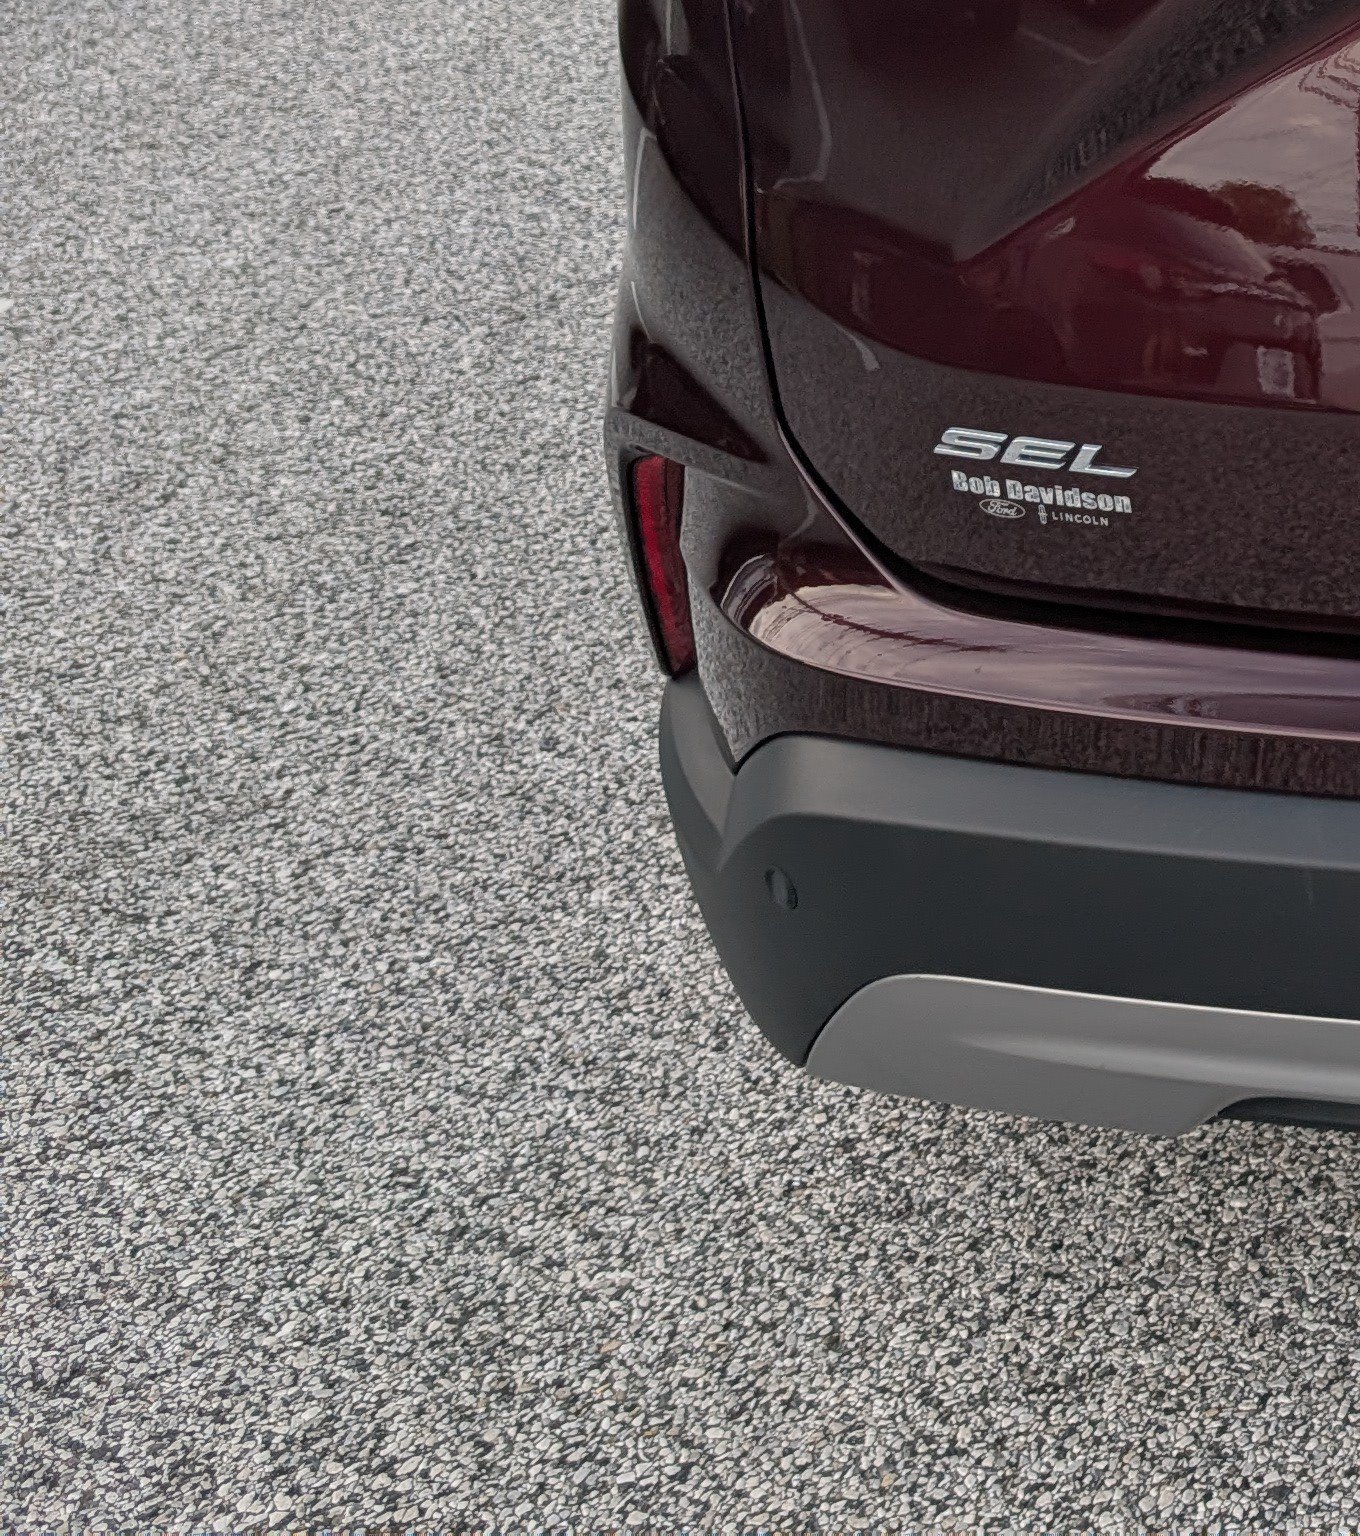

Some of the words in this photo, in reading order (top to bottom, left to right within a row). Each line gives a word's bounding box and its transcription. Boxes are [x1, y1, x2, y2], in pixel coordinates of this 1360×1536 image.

[933, 426, 1139, 478] SEL
[951, 469, 1000, 497] Bob
[1005, 478, 1132, 514] Davidson
[987, 502, 1017, 516] Ford
[1051, 511, 1109, 527] LINCOLN
